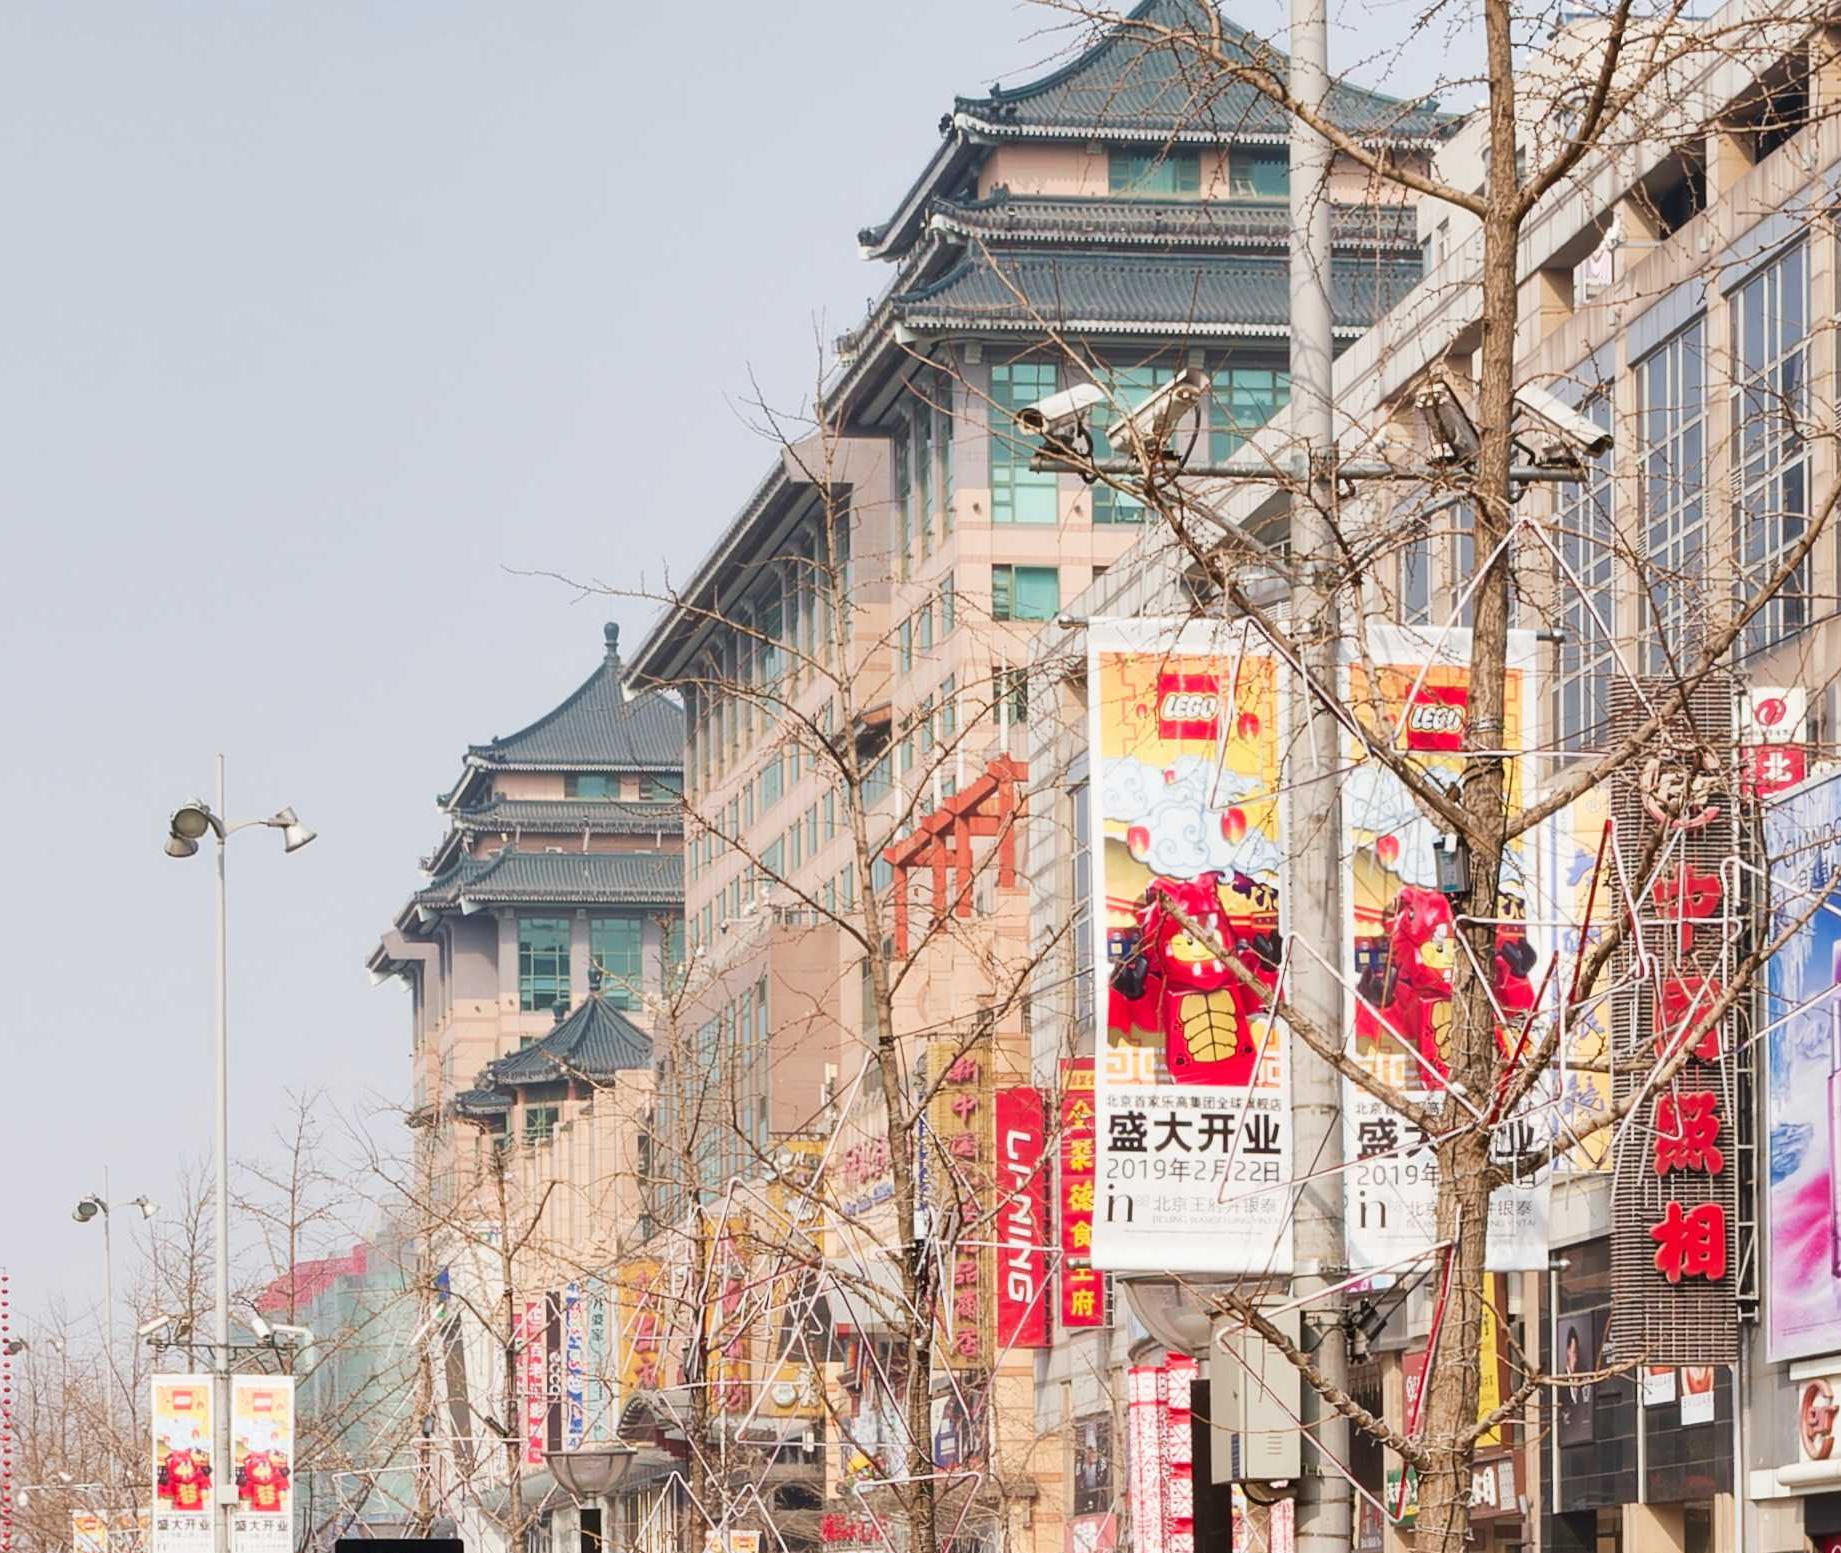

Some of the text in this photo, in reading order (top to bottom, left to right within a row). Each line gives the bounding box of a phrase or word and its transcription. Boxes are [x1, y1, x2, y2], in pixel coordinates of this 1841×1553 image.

[1162, 693, 1219, 720] LEGO
[1411, 704, 1464, 732] LEGO
[1761, 752, 1792, 782] 北
[1107, 1110, 1282, 1155] 盛大开业
[1356, 1117, 1535, 1161] 盛大业
[1106, 1157, 1281, 1183] 2019年2月22日
